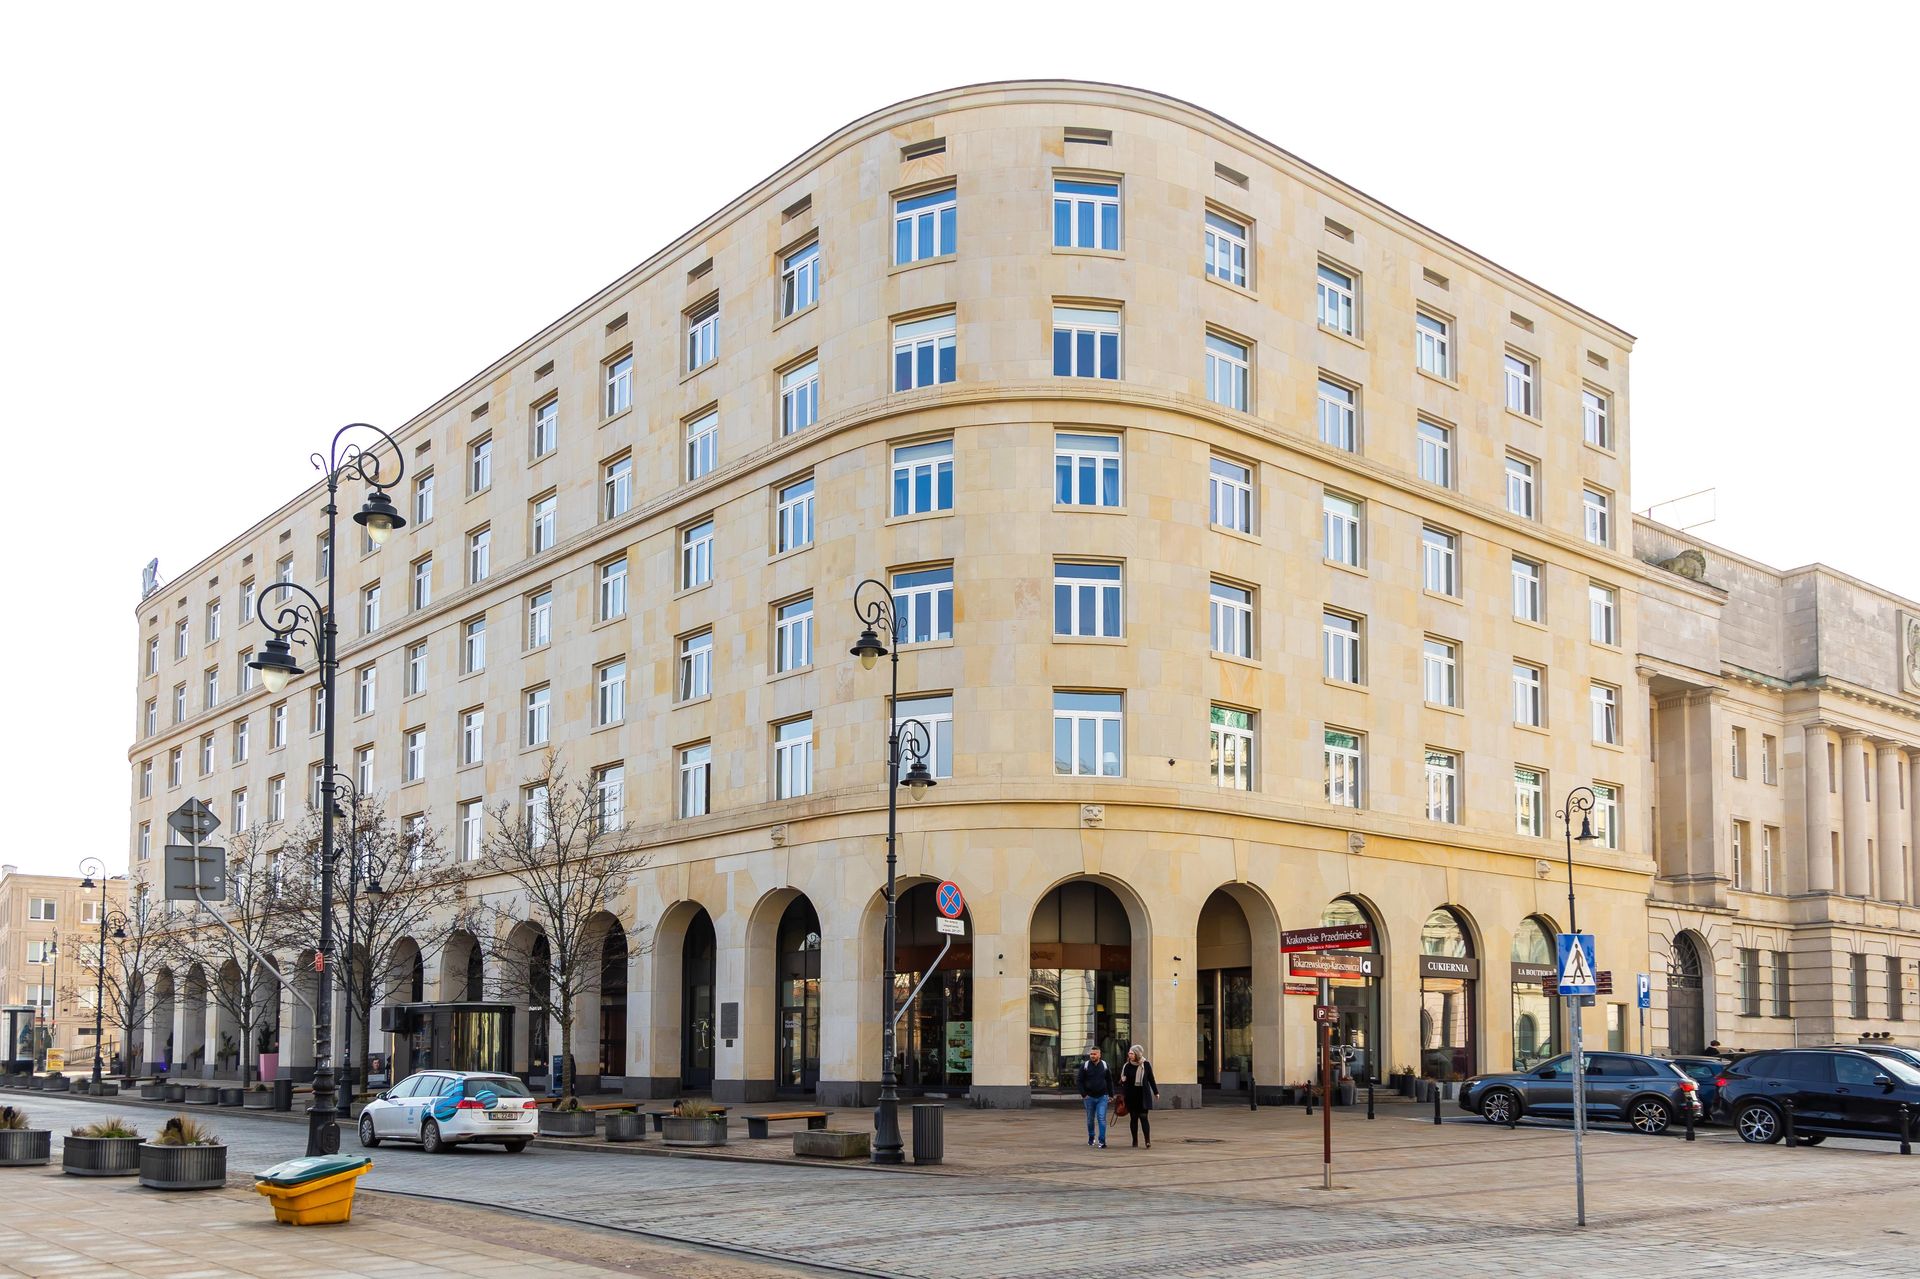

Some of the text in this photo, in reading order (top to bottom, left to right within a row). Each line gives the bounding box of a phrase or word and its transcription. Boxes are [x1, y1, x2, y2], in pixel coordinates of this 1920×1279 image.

[1286, 929, 1363, 945] Krakowskie Przedmieście
[1427, 961, 1469, 973] CUKIERNIA
[1518, 968, 1526, 976] LA
